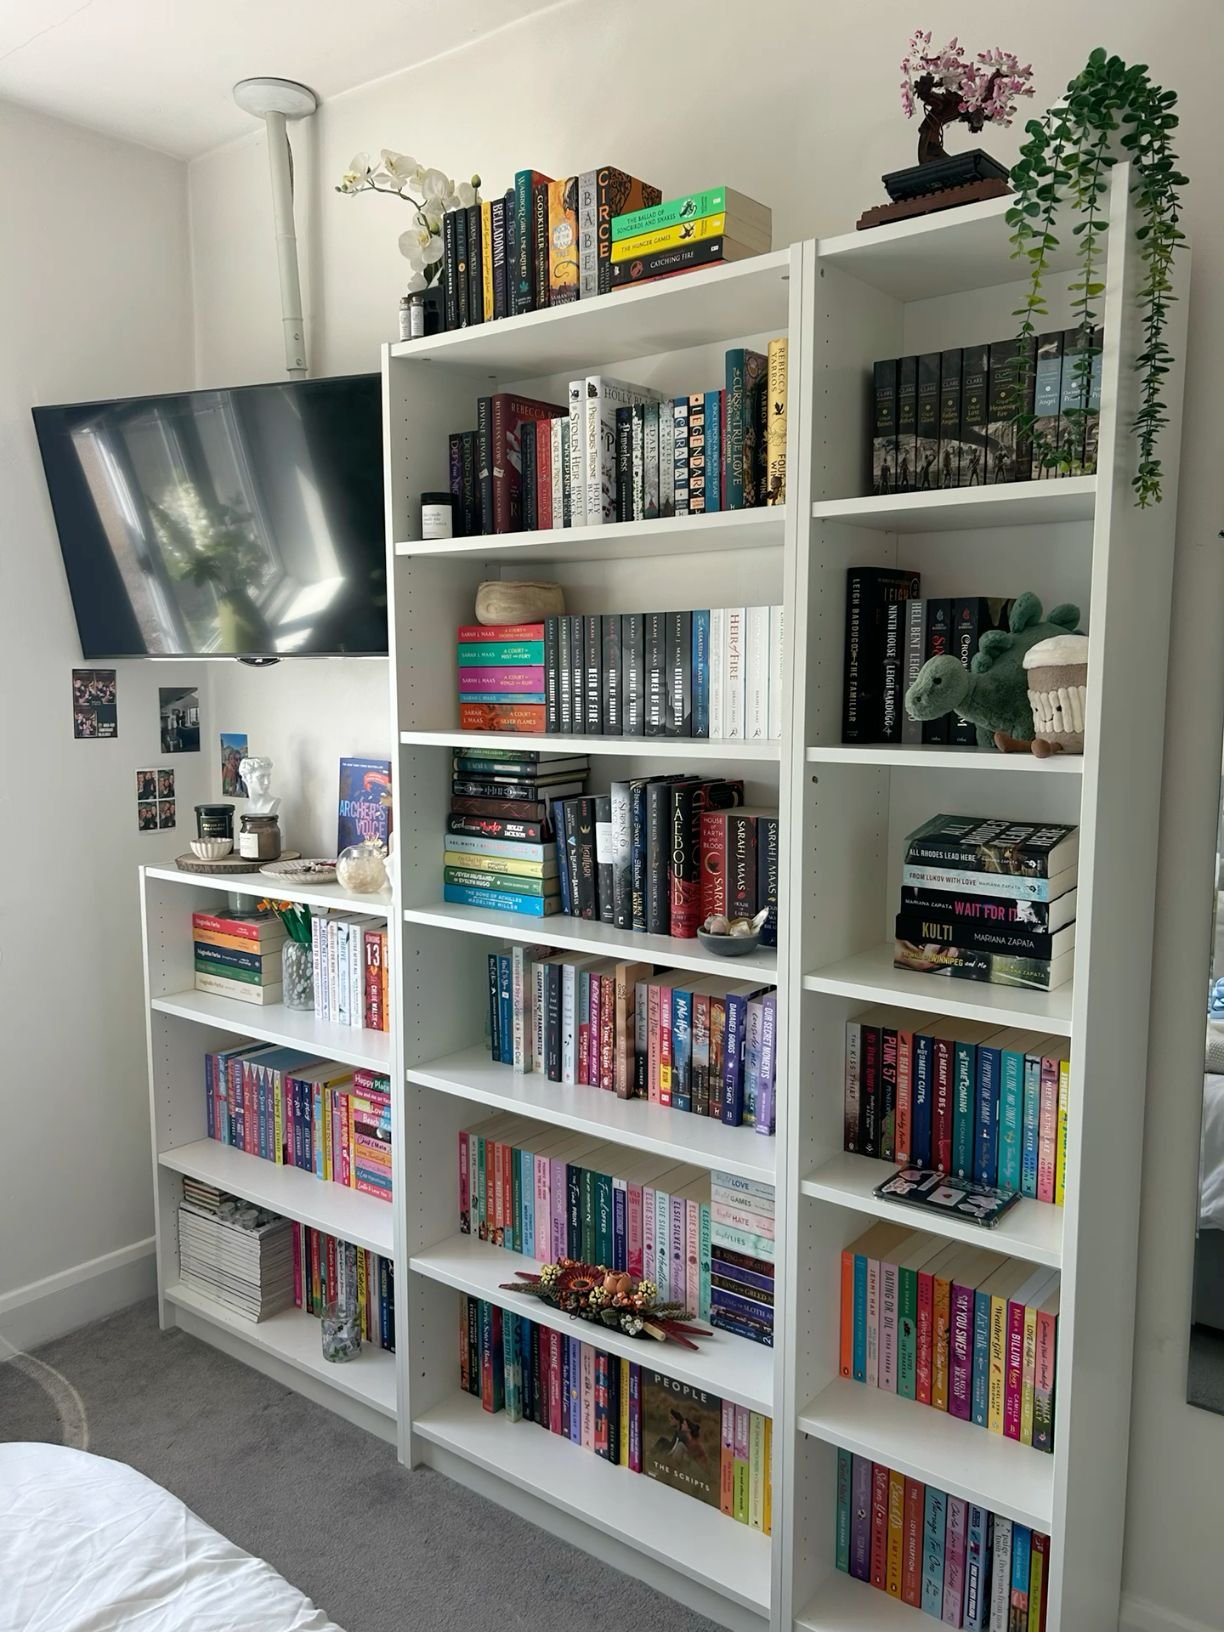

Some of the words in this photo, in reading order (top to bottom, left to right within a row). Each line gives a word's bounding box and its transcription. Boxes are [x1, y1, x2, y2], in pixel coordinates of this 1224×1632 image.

[518, 175, 528, 216] WARRIOR
[519, 217, 527, 234] GIRL
[537, 194, 546, 249] GODKILLER
[598, 170, 610, 258] CIRCE
[627, 213, 638, 224] THE
[638, 210, 656, 222] BALLAD
[644, 218, 656, 228] AND
[493, 203, 505, 268] BELLADONNA
[583, 191, 593, 291] BABEL
[632, 240, 652, 251] HUNGER
[650, 254, 680, 269] CATCHING
[681, 251, 695, 261] FIRE
[778, 347, 786, 394] REBECCA
[479, 402, 487, 433] DIVINE
[570, 413, 581, 453] STOLEN
[479, 437, 487, 466] RIVALS
[675, 418, 688, 488] CARAVAL
[692, 405, 704, 498] LEGENDARY
[571, 456, 582, 480] HEIR
[733, 455, 742, 486] LOVE
[575, 485, 584, 517] HOLLY
[593, 483, 601, 515] HOLLY
[887, 605, 899, 630] NINTH
[910, 602, 922, 624] HELL
[730, 614, 740, 646] HEIR
[910, 626, 922, 649] BENT
[886, 631, 898, 657] HOUSE
[589, 668, 598, 687] HEIR
[729, 654, 740, 681] FIRE
[885, 665, 897, 688] LEIGH
[651, 669, 659, 692] TOWER
[589, 691, 597, 700] OF
[848, 680, 858, 722] FAMILIAR
[589, 704, 598, 723] FIRE
[355, 820, 386, 840] VOICE
[632, 822, 641, 847] Sword
[737, 820, 745, 853] SARAH
[768, 822, 777, 856] SARAH
[673, 792, 684, 906] FAEBOUND
[910, 848, 921, 857] ALL
[921, 849, 944, 859] RHODES
[944, 851, 960, 861] LEAD
[960, 853, 977, 862] HERE
[633, 859, 641, 890] Shadow
[737, 862, 745, 891] MAAS
[768, 865, 777, 894] MAAS
[909, 872, 925, 882] FROM
[926, 874, 944, 884] LUKOV
[945, 875, 960, 885] WITH
[960, 877, 977, 886] LOVE
[954, 900, 981, 917] WAIT
[984, 905, 1005, 922] FOR
[922, 922, 953, 941] KULTI
[973, 932, 1006, 945] MARIANA
[1006, 936, 1035, 949] ZAPATA
[366, 943, 380, 966] 13
[661, 1004, 669, 1028] WOMAN
[728, 1003, 737, 1033] DAMAGED
[764, 1007, 773, 1021] OUR
[727, 1034, 736, 1054] GOODS
[762, 1021, 772, 1046] SECRET
[661, 1040, 669, 1056] MAN
[883, 1036, 897, 1065] PUNK
[761, 1046, 770, 1079] MOMENTS
[849, 1051, 858, 1070] KISS
[918, 1060, 926, 1080] MEET
[939, 1058, 947, 1084] MEANT
[959, 1060, 969, 1080] TIME
[884, 1067, 896, 1083] 57
[959, 1080, 969, 1113] COMING
[1045, 1080, 1053, 1099] MEET
[1043, 1135, 1052, 1153] LAKE
[731, 1179, 750, 1190] LOVE
[658, 1196, 666, 1216] ELSIE
[673, 1200, 681, 1222] ELSIE
[730, 1194, 752, 1207] GAMES
[688, 1205, 697, 1226] ELSIE
[702, 1209, 710, 1232] ELSIE
[732, 1214, 750, 1226] HATE
[658, 1216, 666, 1245] SILVER
[673, 1222, 681, 1251] SILVER
[688, 1227, 697, 1255] SILVER
[729, 1235, 746, 1246] LIES
[702, 1232, 710, 1258] SILVER
[884, 1270, 895, 1299] DATING
[884, 1301, 894, 1313] DR.
[957, 1295, 968, 1311] SAY
[883, 1317, 894, 1329] DIL
[956, 1311, 967, 1328] YOU
[993, 1306, 1003, 1341] Weather
[955, 1329, 966, 1361] SWEAR
[976, 1329, 988, 1348] Talk
[1010, 1333, 1020, 1367] BILLION
[550, 1333, 558, 1369] QUEENIE
[991, 1342, 1001, 1361] Girl
[655, 1374, 707, 1403] PEOPLE
[654, 1461, 670, 1474] THE
[674, 1469, 710, 1491] SCRIPTS
